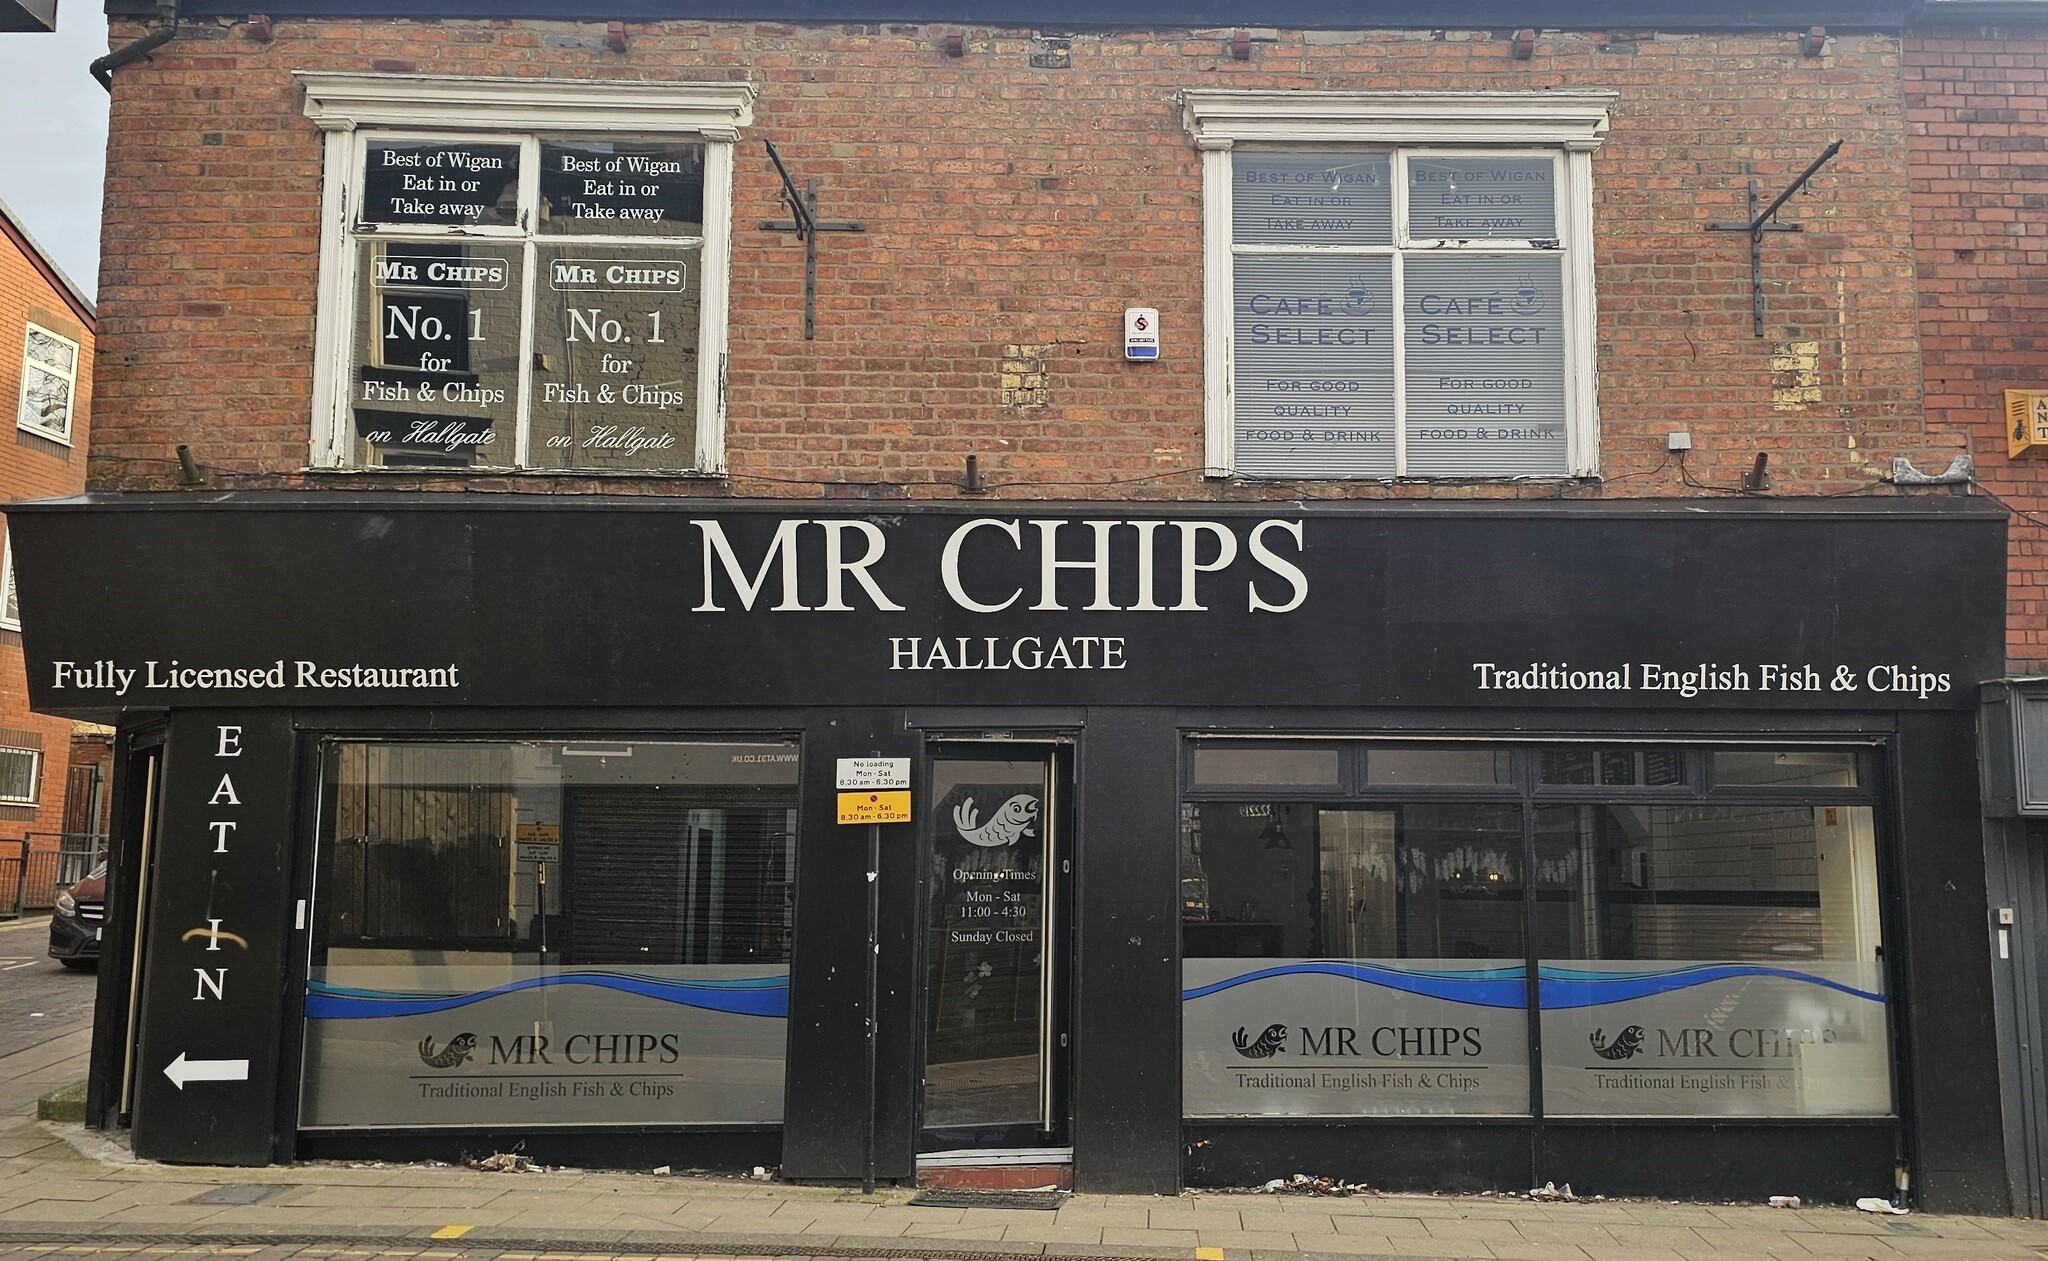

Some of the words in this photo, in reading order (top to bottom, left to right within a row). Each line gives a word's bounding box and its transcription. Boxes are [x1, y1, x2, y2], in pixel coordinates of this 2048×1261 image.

[383, 151, 421, 167] Best
[426, 152, 446, 168] of
[449, 153, 502, 173] Wigan
[562, 156, 600, 171] Best
[605, 157, 625, 172] of
[628, 157, 680, 175] Wigan
[403, 175, 435, 191] Eat
[439, 176, 457, 191] in
[461, 180, 480, 192] or
[584, 180, 616, 195] Eat
[620, 181, 637, 196] in
[640, 185, 659, 196] or
[391, 199, 434, 214] Take
[438, 204, 484, 218] away
[572, 203, 614, 219] Take
[619, 209, 664, 222] away
[375, 262, 418, 280] MR
[428, 263, 502, 282] CHIPS
[555, 265, 597, 284] MR
[606, 266, 680, 285] CHIPS
[386, 306, 451, 341] No.
[468, 309, 485, 341] 1
[566, 309, 630, 343] No.
[647, 312, 664, 343] 1
[1251, 324, 1375, 345] SELECT
[1422, 324, 1546, 345] SELECT
[420, 352, 451, 372] for
[601, 354, 631, 373] for
[363, 382, 408, 401] Fish
[417, 383, 436, 402] &
[440, 383, 504, 407] Chips
[544, 384, 589, 404] Fish
[597, 385, 616, 404] &
[622, 385, 683, 408] Chips
[1274, 405, 1351, 417] QUALITY
[1448, 404, 1525, 415] QUALITY
[366, 429, 391, 442] on
[403, 421, 496, 450] Hallgate
[547, 433, 572, 447] on
[582, 425, 675, 456] Hallgate
[1246, 430, 1294, 441] FOOD
[1302, 429, 1315, 441] &
[1324, 431, 1381, 442] DRINK
[1420, 429, 1468, 439] FOOD
[1476, 428, 1488, 439] &
[1498, 429, 1554, 440] DRINK
[689, 519, 906, 612] MR
[941, 518, 1308, 613] CHIPS
[888, 637, 1127, 670] HALLGATE
[52, 660, 136, 695] Fully
[145, 660, 284, 689] Licensed
[294, 660, 459, 689] Restaurant
[1473, 663, 1631, 690] Traditional
[1640, 663, 1751, 696] English
[1758, 664, 1821, 692] Fish
[1830, 666, 1858, 692] &
[1867, 666, 1951, 699] Chips
[208, 726, 242, 853] EAT
[953, 869, 1001, 882] Opening
[1003, 869, 1036, 880] Times
[966, 891, 992, 901] Mon
[1004, 891, 1020, 901] Sat
[961, 907, 990, 917] 11:00
[1002, 907, 1026, 917] 4:30
[952, 931, 992, 944] Sunday
[996, 931, 1033, 942] Closed
[193, 919, 228, 1000] IN
[488, 1035, 553, 1065] MR
[565, 1034, 679, 1064] CHIPS
[1300, 1027, 1361, 1056] MR
[1372, 1027, 1482, 1056] CHIPS
[1657, 1029, 1718, 1057] MR
[419, 1083, 502, 1098] Traditional
[509, 1083, 566, 1100] English
[572, 1082, 604, 1096] Fish
[610, 1082, 624, 1096] &
[629, 1082, 674, 1100] Chips
[1236, 1074, 1315, 1088] Traditional
[1322, 1074, 1376, 1090] English
[1382, 1074, 1412, 1088] Fish
[1418, 1074, 1431, 1088] &
[1437, 1074, 1479, 1090] Chips
[1594, 1075, 1674, 1089] Traditional
[1681, 1075, 1735, 1092] English
[1741, 1074, 1770, 1089] Fish
[1776, 1077, 1789, 1089] &
